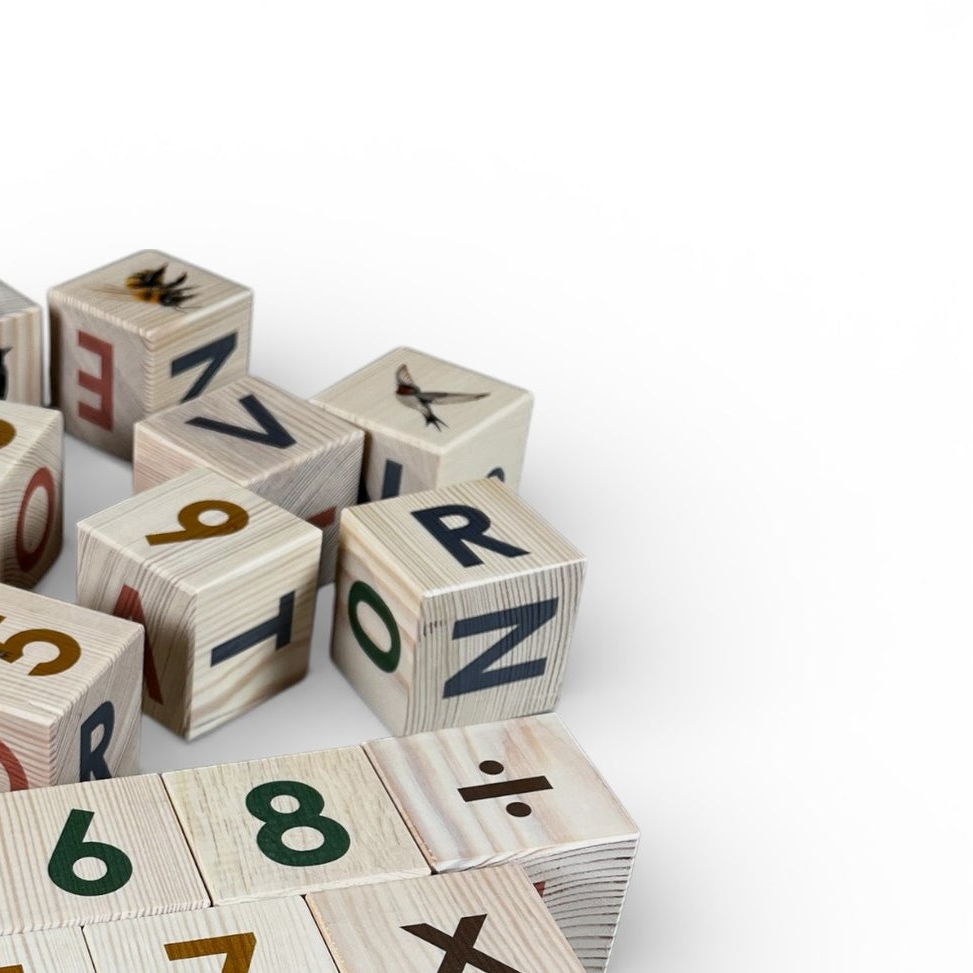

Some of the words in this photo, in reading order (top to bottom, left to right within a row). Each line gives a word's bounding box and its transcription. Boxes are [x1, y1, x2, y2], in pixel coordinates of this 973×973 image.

[77, 331, 116, 431] E
[186, 394, 297, 450] V
[410, 504, 530, 568] R
[211, 590, 295, 668] T
[80, 700, 113, 782] R
[47, 808, 133, 897] 6
[245, 780, 351, 867] 8
